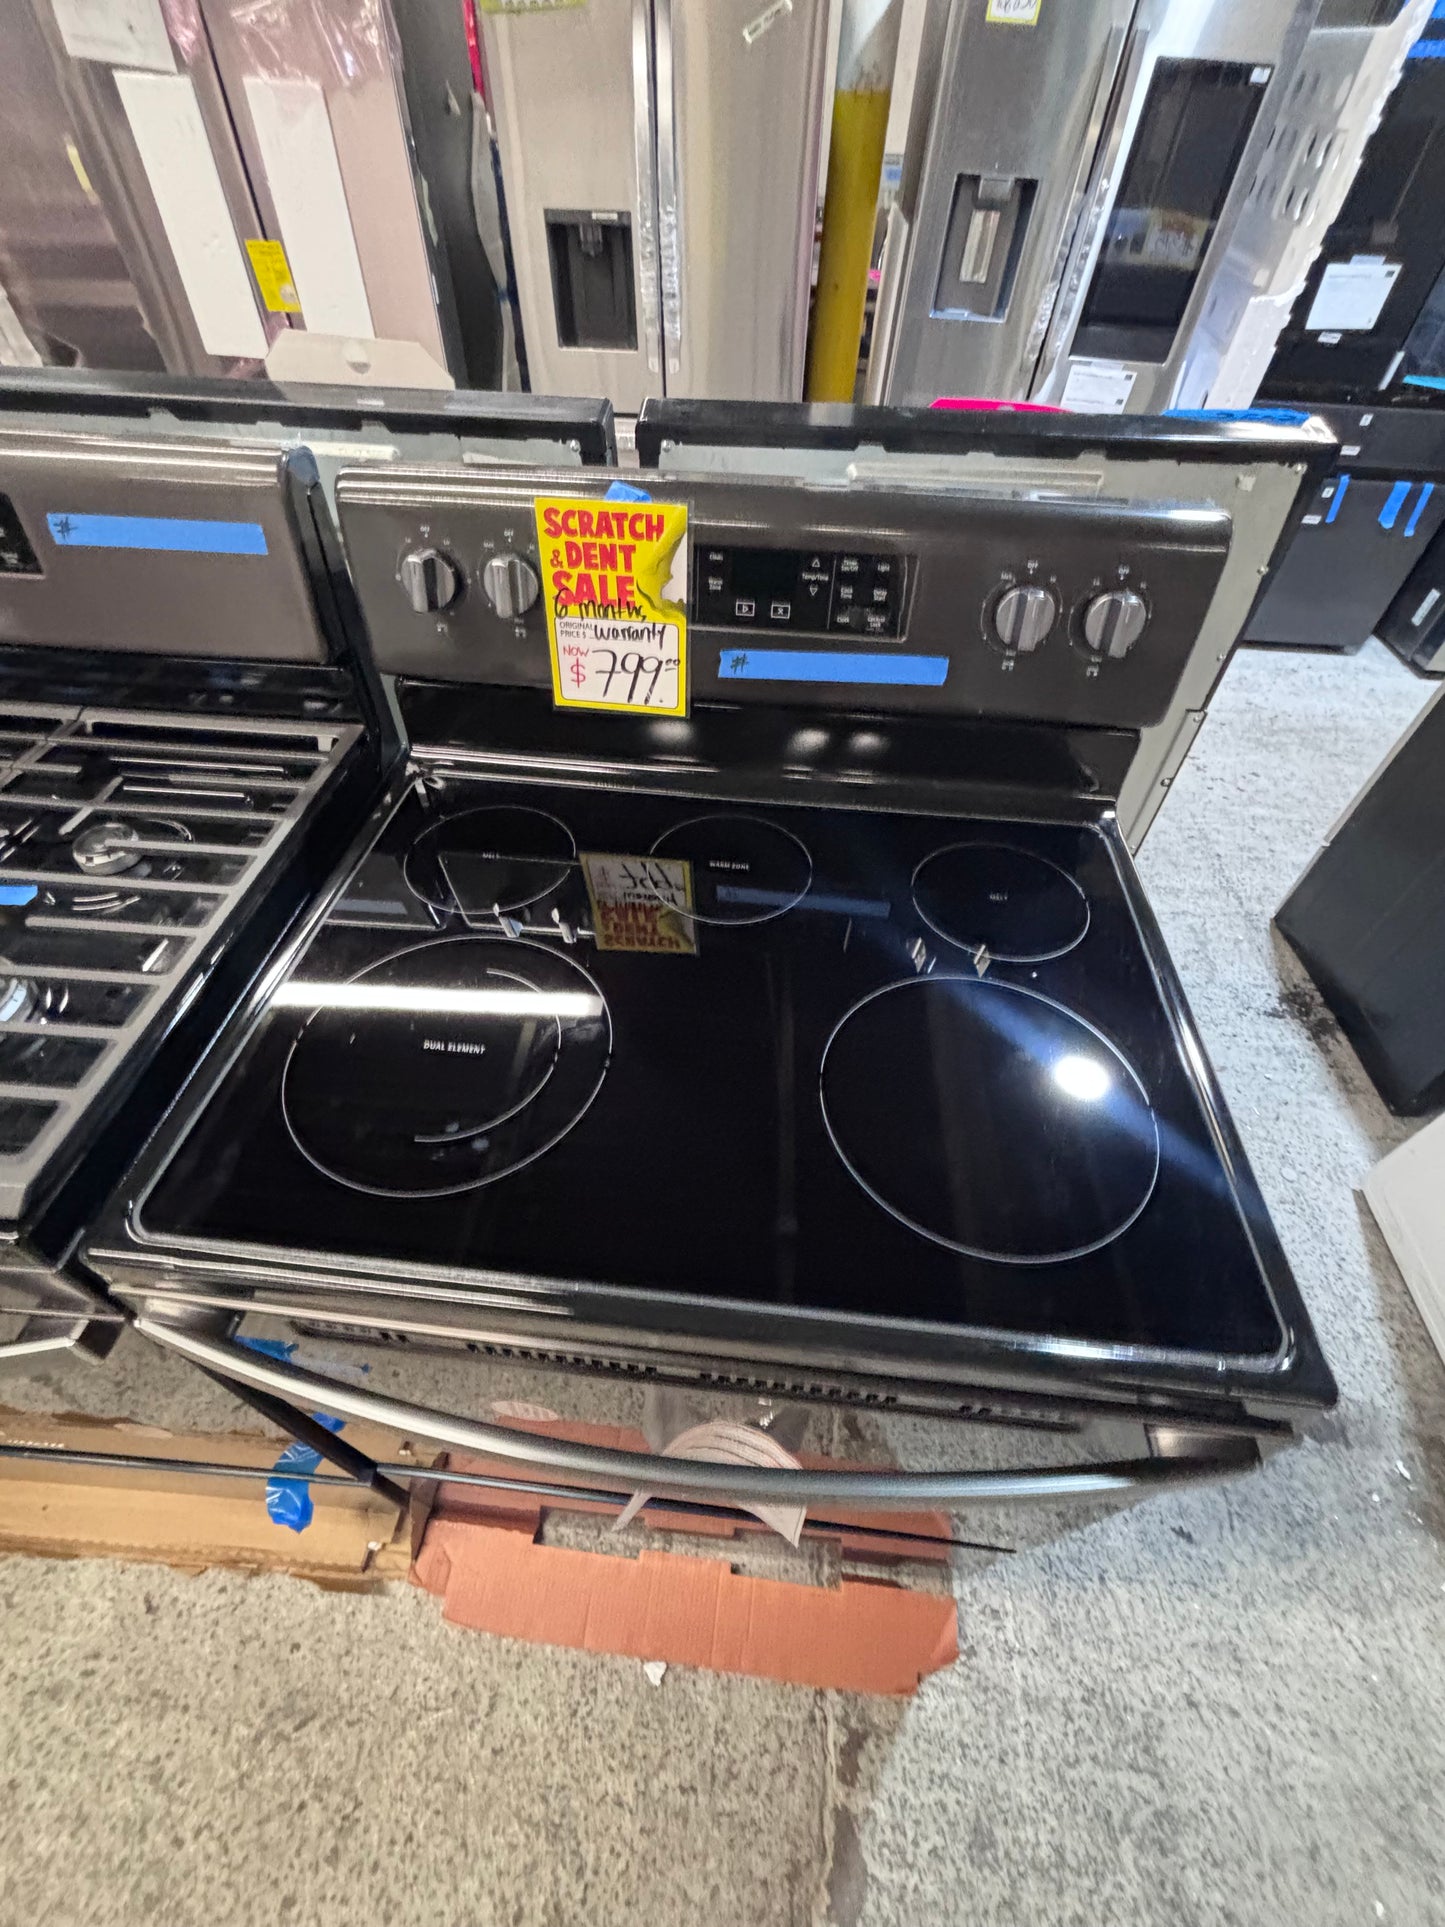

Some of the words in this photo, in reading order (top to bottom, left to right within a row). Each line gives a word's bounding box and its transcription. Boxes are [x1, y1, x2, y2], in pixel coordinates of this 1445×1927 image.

[543, 507, 665, 541] SCRATCH
[550, 549, 563, 568] &
[565, 541, 637, 573] DENT
[552, 570, 635, 608] SALE
[554, 588, 569, 619] 6
[559, 622, 593, 632] ORIGINAL
[560, 630, 580, 638] PRICE
[562, 644, 590, 657] NOW
[569, 656, 587, 689] $
